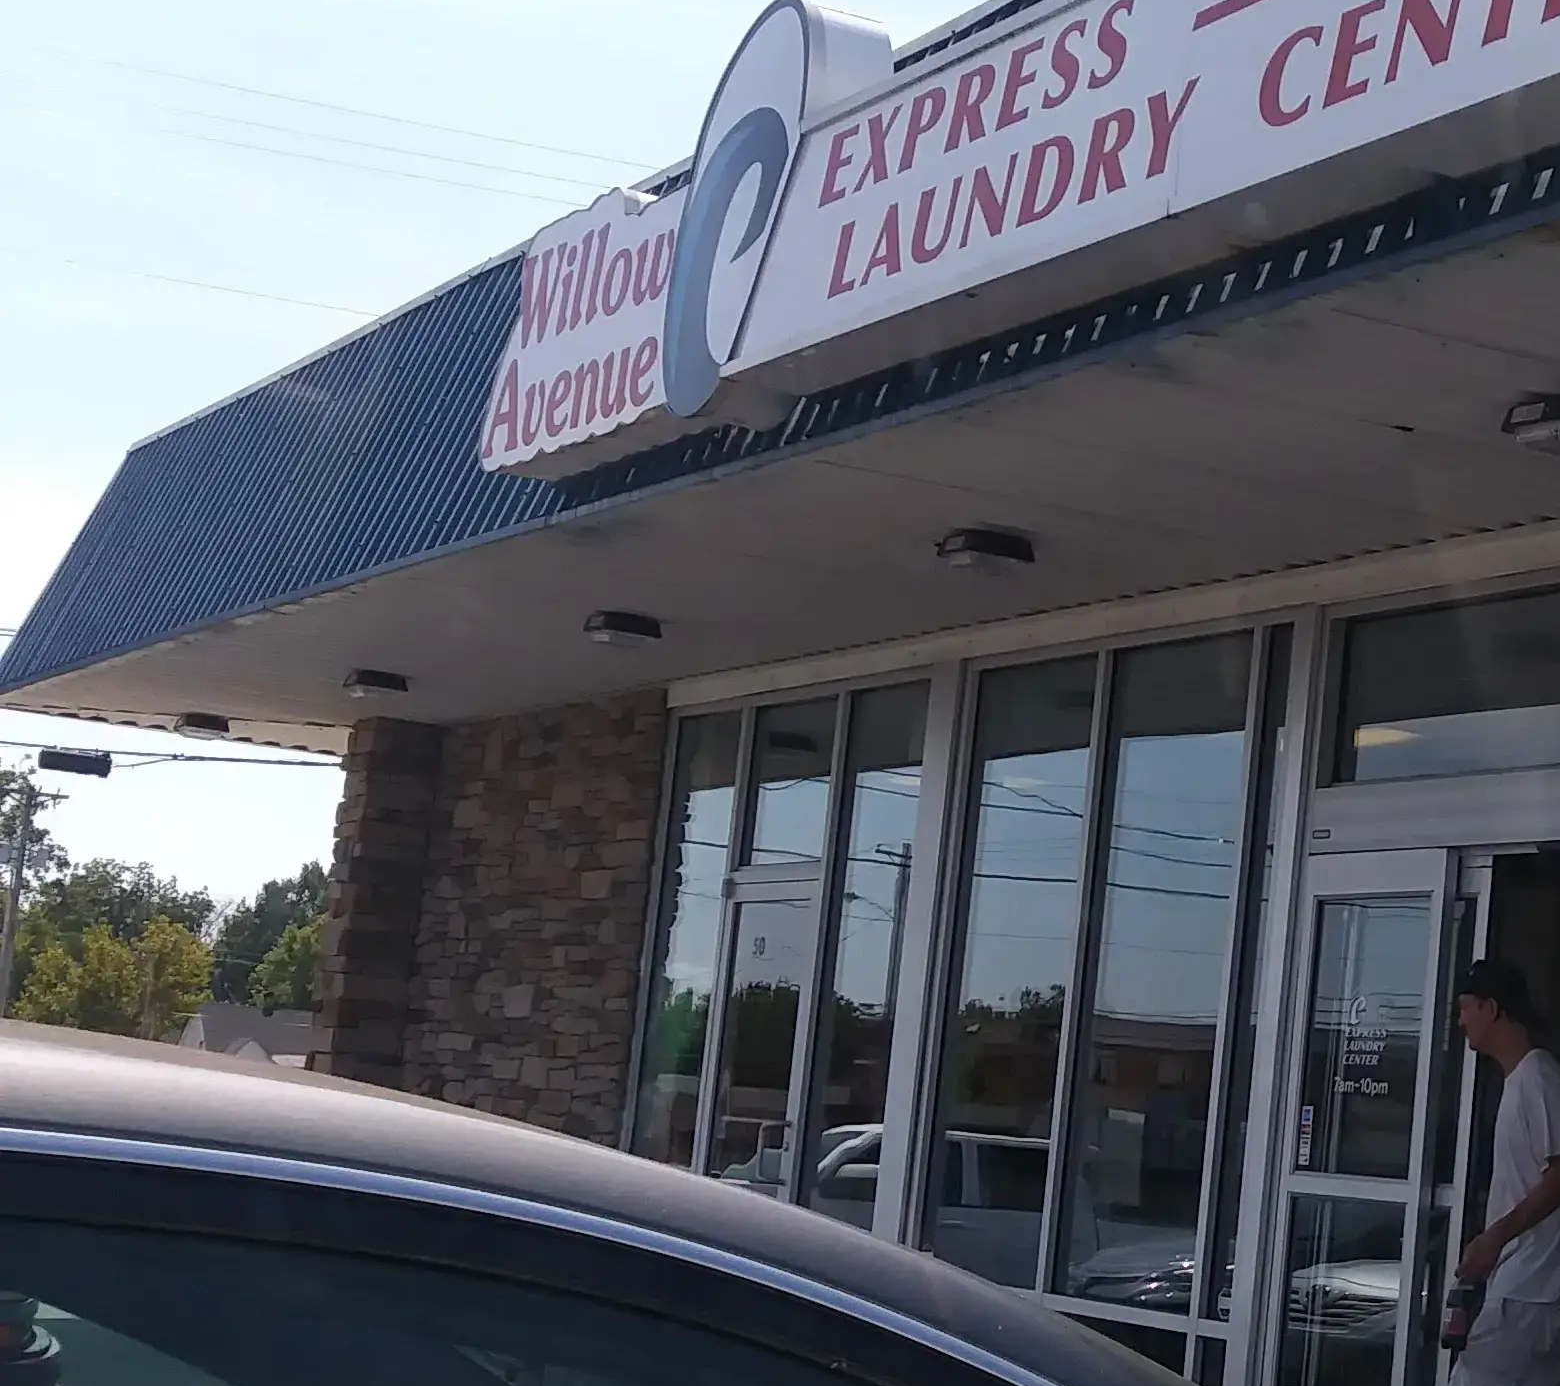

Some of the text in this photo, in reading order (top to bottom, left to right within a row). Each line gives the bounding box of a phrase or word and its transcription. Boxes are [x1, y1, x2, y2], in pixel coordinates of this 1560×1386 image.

[827, 76, 1200, 300] LAUNDRY
[521, 222, 675, 349] Willow
[482, 335, 658, 459] Avenue
[1342, 1054, 1380, 1066] CENTER
[1343, 1040, 1386, 1052] LAUNDRY
[1333, 1076, 1389, 1097] 7am-10pm
